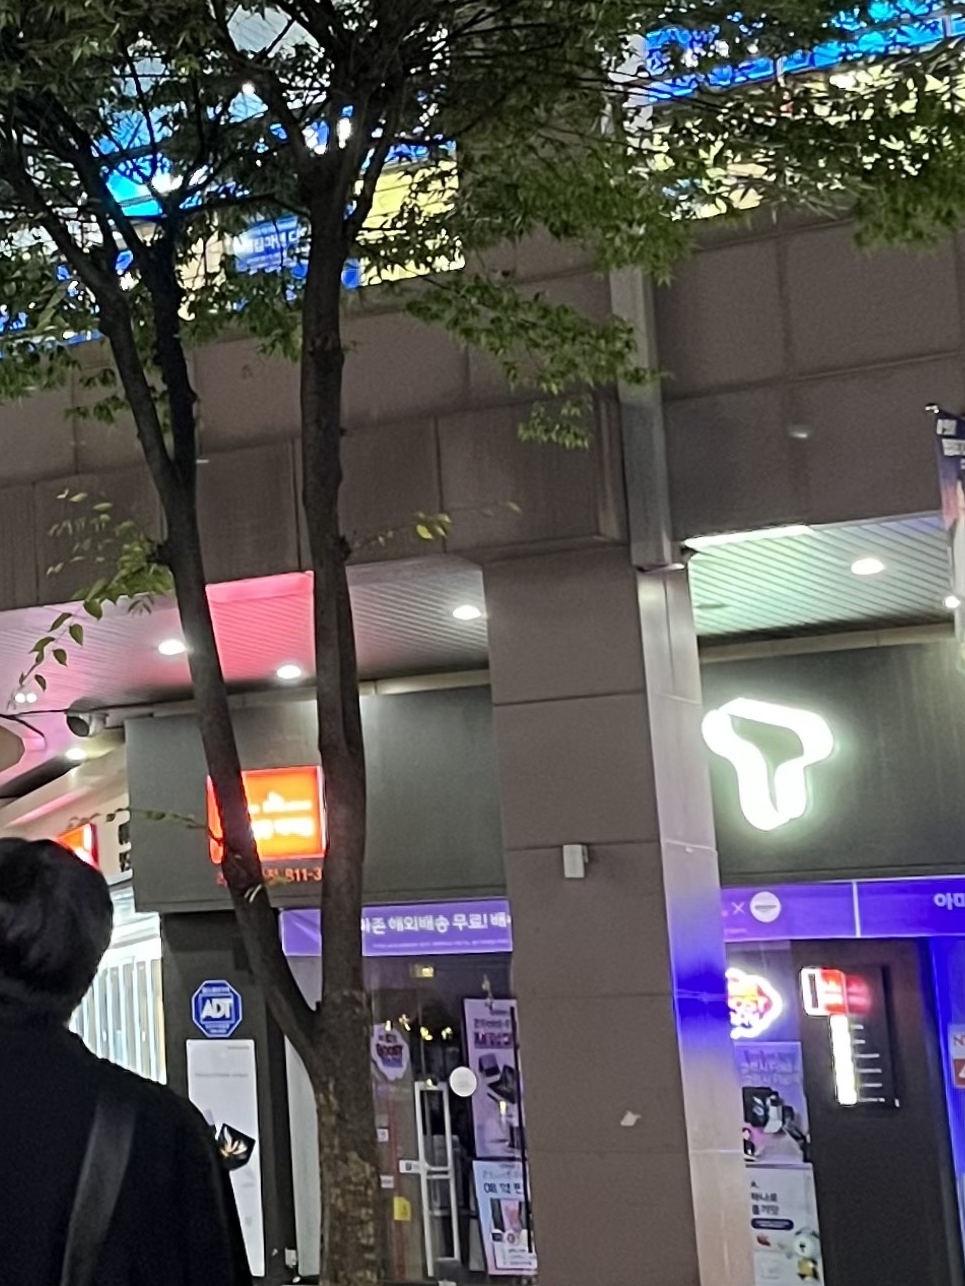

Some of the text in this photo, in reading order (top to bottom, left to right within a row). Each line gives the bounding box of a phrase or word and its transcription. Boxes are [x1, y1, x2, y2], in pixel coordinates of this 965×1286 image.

[388, 914, 450, 933] 해외배송
[490, 911, 512, 928] 배
[200, 997, 234, 1020] ADT
